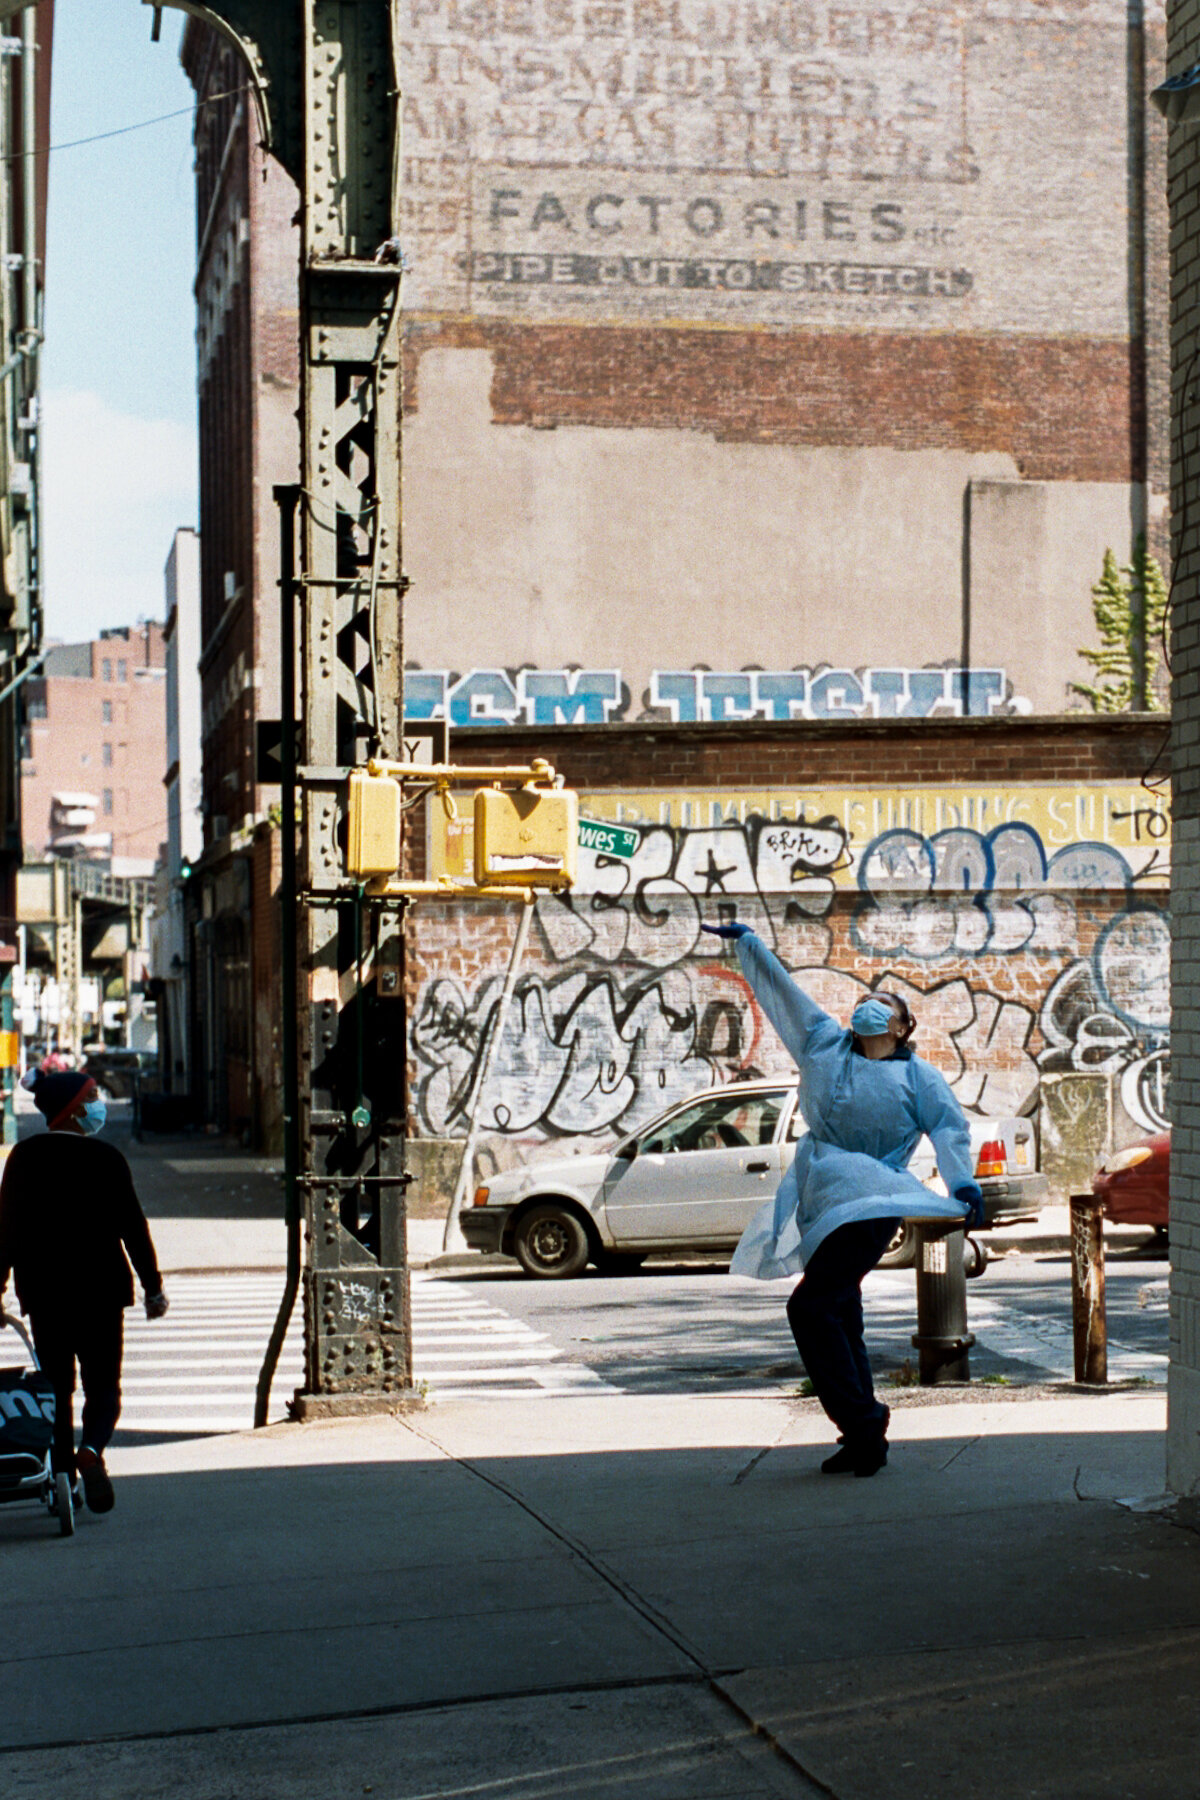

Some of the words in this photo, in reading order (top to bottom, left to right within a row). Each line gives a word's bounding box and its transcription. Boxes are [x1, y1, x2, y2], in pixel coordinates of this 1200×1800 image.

[487, 187, 906, 243] FACTORIES
[474, 255, 577, 282] PIPE
[696, 262, 752, 288] TO
[779, 264, 951, 295] SKETCH
[578, 825, 616, 851] wes
